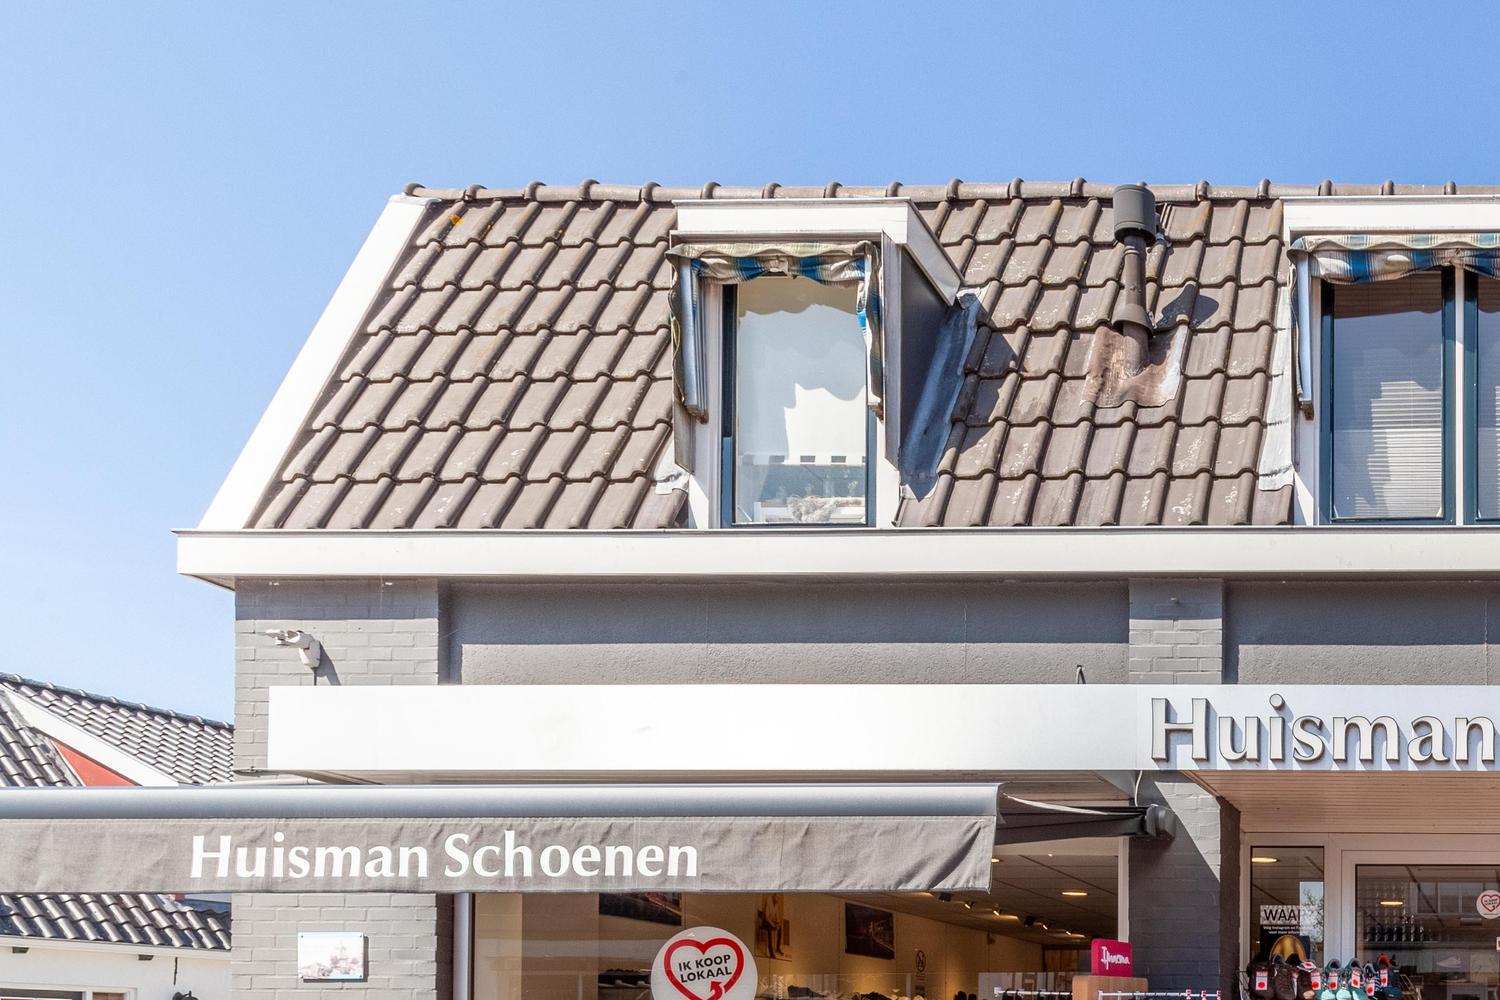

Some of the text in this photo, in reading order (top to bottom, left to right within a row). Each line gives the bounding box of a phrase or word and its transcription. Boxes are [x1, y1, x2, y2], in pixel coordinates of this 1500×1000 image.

[1151, 693, 1495, 763] Huisman
[190, 831, 697, 880] Huisman Schoenen
[678, 954, 731, 972] IK KOOP
[680, 966, 732, 983] LOKAAL
